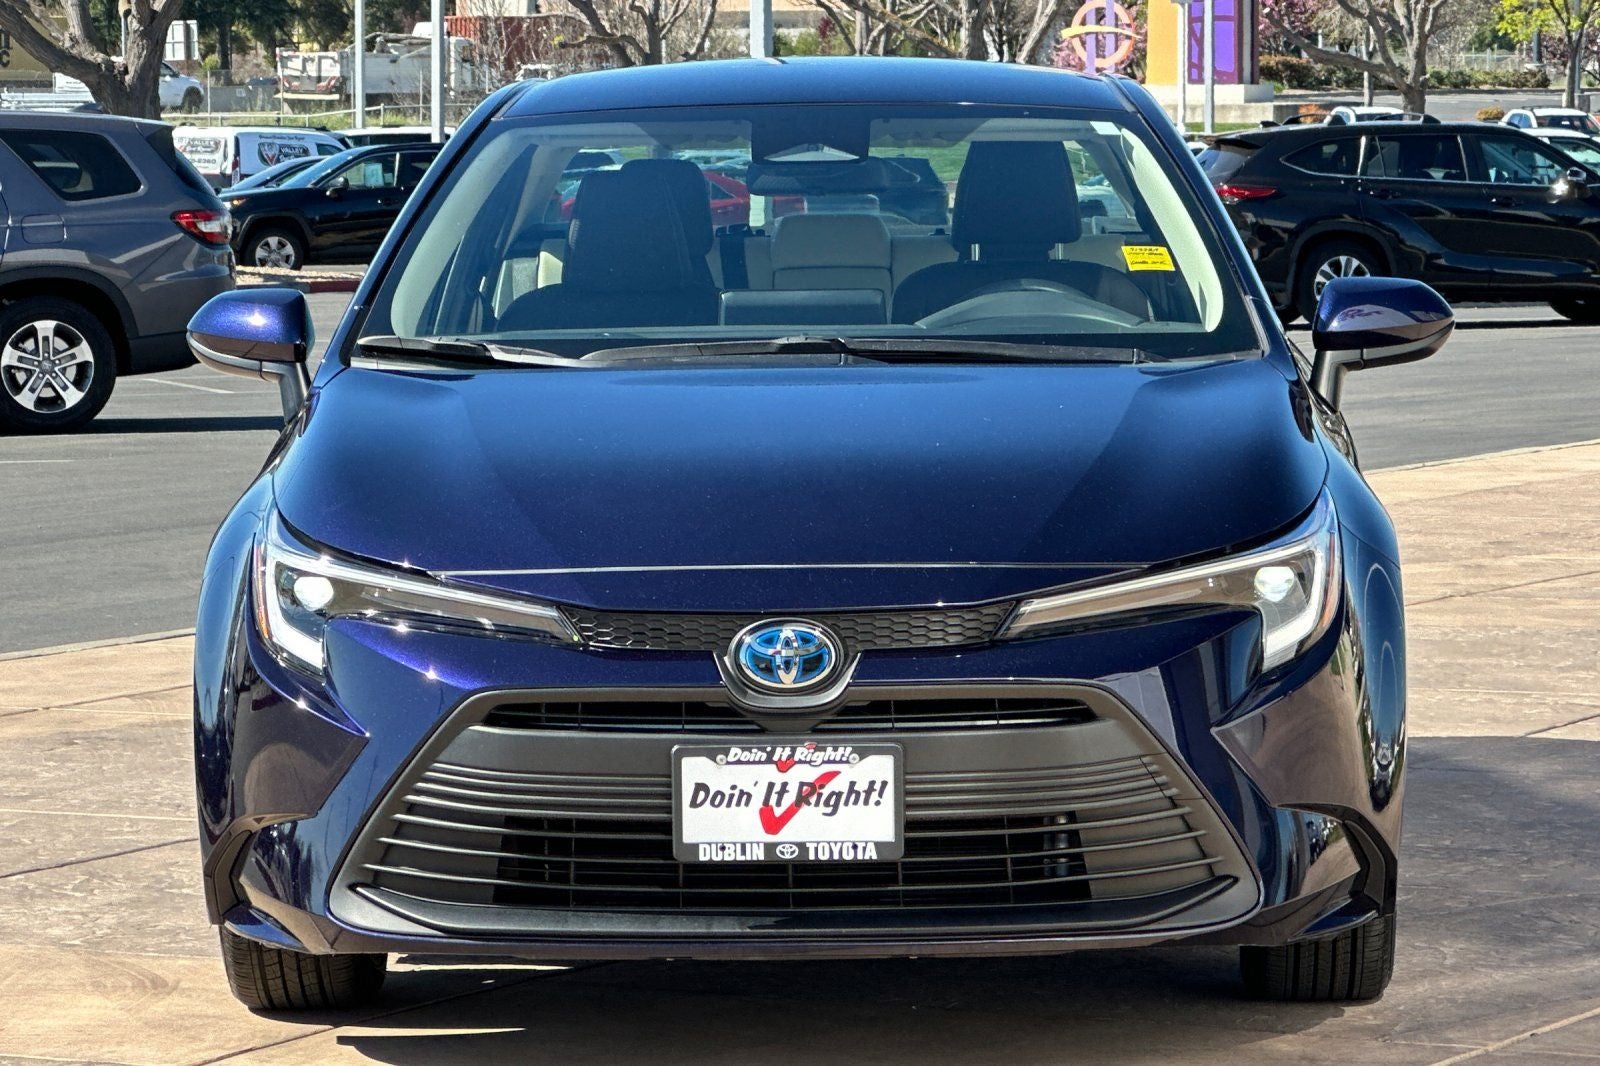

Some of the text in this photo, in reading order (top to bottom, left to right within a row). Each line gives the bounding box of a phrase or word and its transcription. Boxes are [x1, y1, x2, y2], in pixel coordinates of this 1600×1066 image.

[727, 747, 853, 766] Doin' It Right!
[689, 779, 889, 817] Doin' It Right!
[698, 842, 878, 861] DUBLIN TOYOTA
